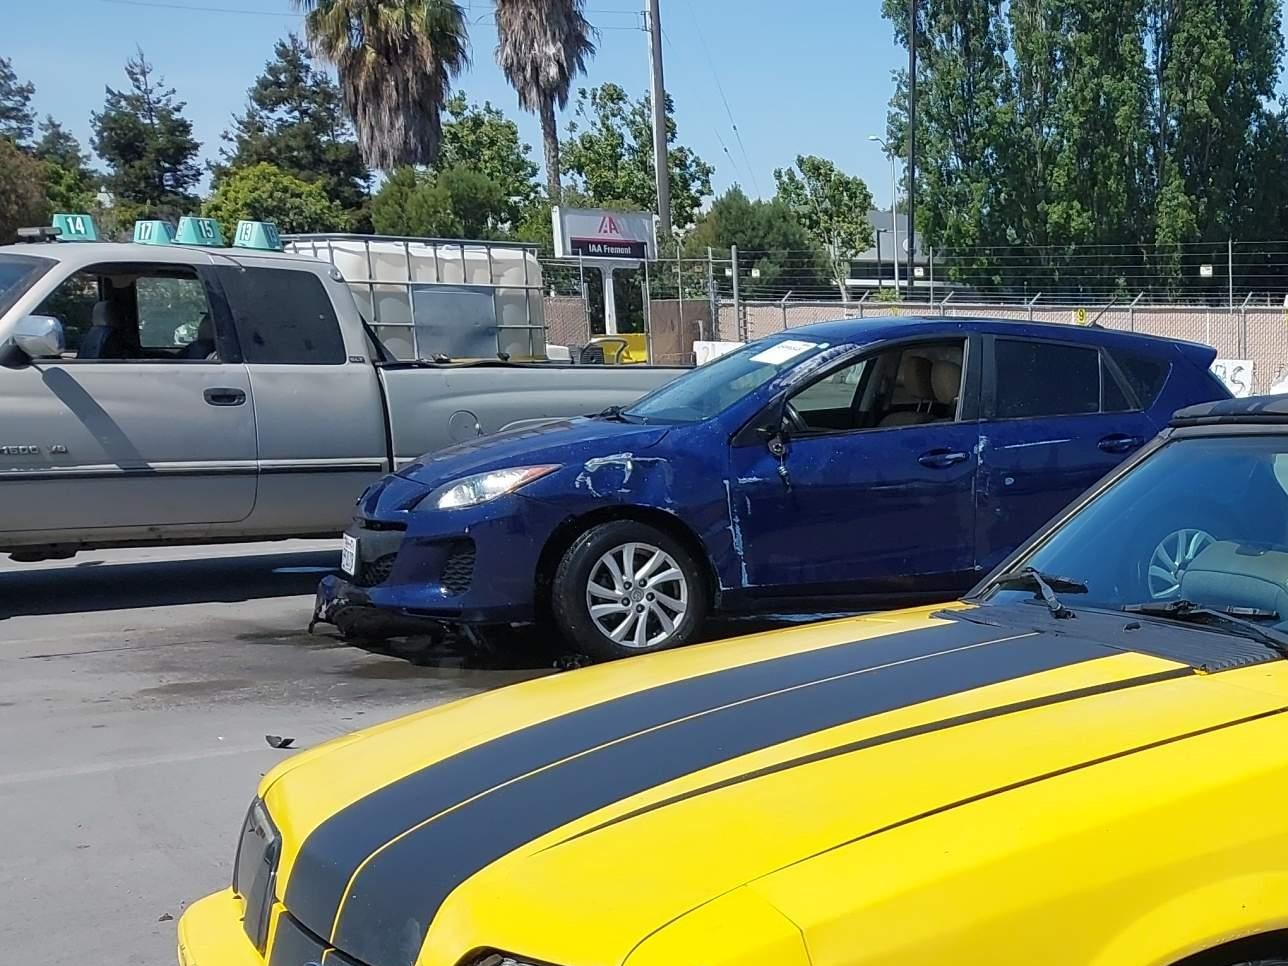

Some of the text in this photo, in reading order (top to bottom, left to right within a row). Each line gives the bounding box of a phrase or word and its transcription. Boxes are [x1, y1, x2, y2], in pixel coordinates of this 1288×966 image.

[66, 216, 85, 234] 14
[139, 222, 153, 240] 17
[199, 220, 215, 239] 15
[241, 223, 252, 241] 13
[588, 243, 632, 255] IAA Fremont
[1077, 310, 1085, 322] 9
